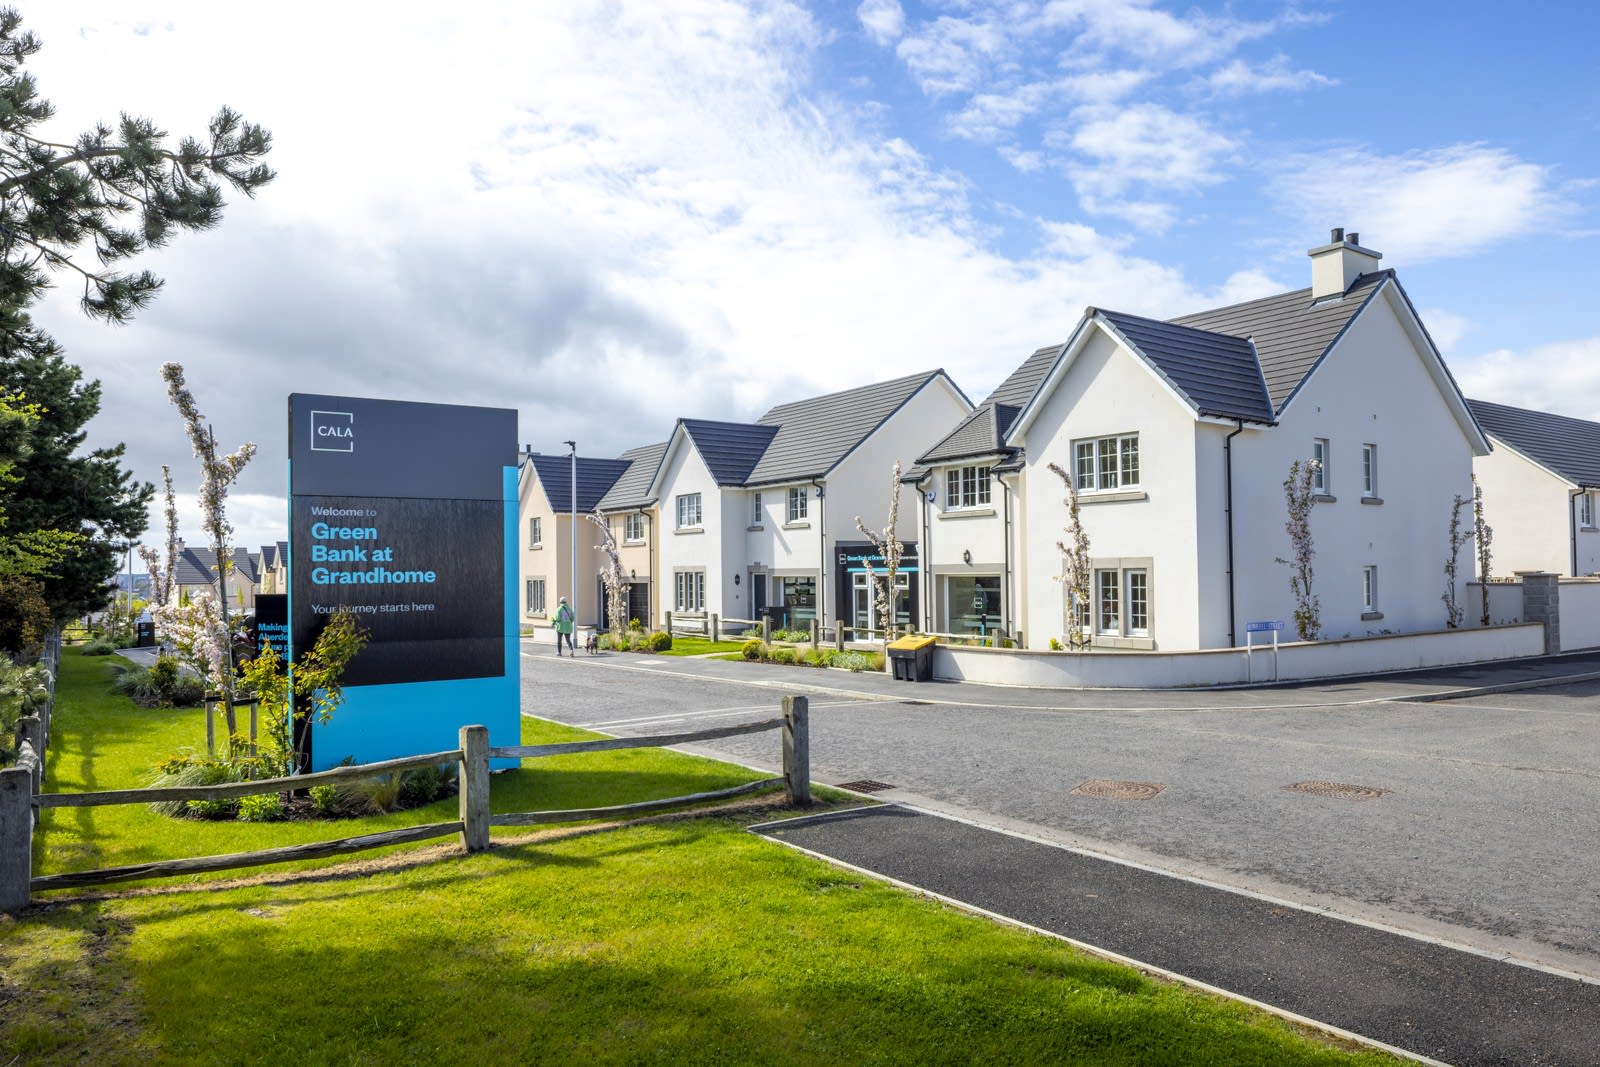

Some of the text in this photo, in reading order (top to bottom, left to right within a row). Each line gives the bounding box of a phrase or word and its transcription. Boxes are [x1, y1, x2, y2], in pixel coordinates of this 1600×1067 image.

[317, 425, 353, 438] CALA
[311, 506, 377, 517] Welcome to
[311, 522, 377, 540] Green
[311, 545, 393, 562] Bank at
[311, 567, 436, 585] Grandhome
[311, 602, 435, 615] Your journey starts here
[258, 623, 288, 633] Making
